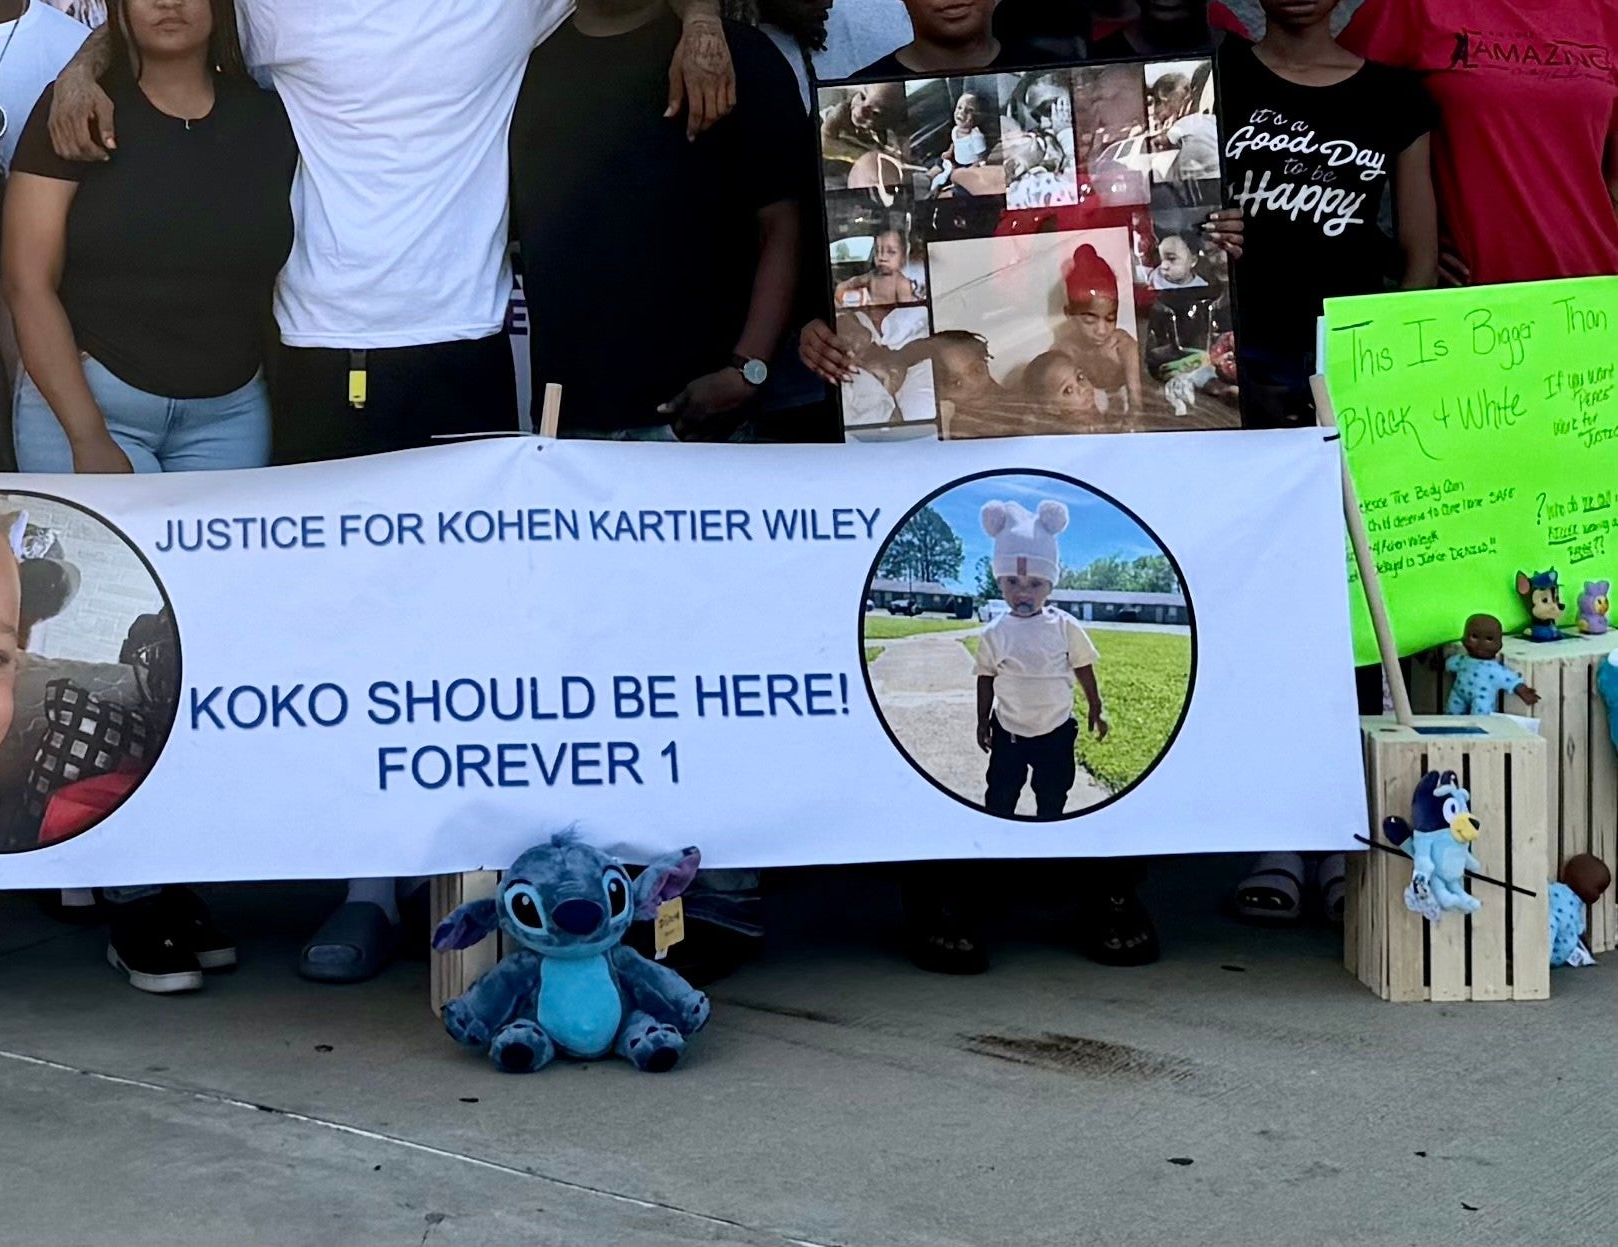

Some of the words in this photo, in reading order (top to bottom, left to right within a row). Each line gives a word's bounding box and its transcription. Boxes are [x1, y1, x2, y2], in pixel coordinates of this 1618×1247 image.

[1225, 125, 1319, 160] Good
[1319, 139, 1387, 182] Day
[1283, 156, 1308, 176] to
[1311, 163, 1338, 183] be
[1232, 168, 1367, 237] Happy
[1331, 319, 1394, 383] This
[1402, 317, 1449, 368] Is
[155, 515, 326, 552] JUSTICE
[339, 513, 426, 548] FOR
[438, 508, 580, 543] KOHEN
[590, 508, 754, 543] KARTIER
[762, 507, 881, 541] WILEY
[190, 682, 349, 730] KOKO
[366, 675, 596, 726] SHOULD
[611, 675, 680, 720] BE
[695, 673, 851, 718] HERE!
[379, 742, 641, 791] FOREVER
[659, 740, 681, 785] 1
